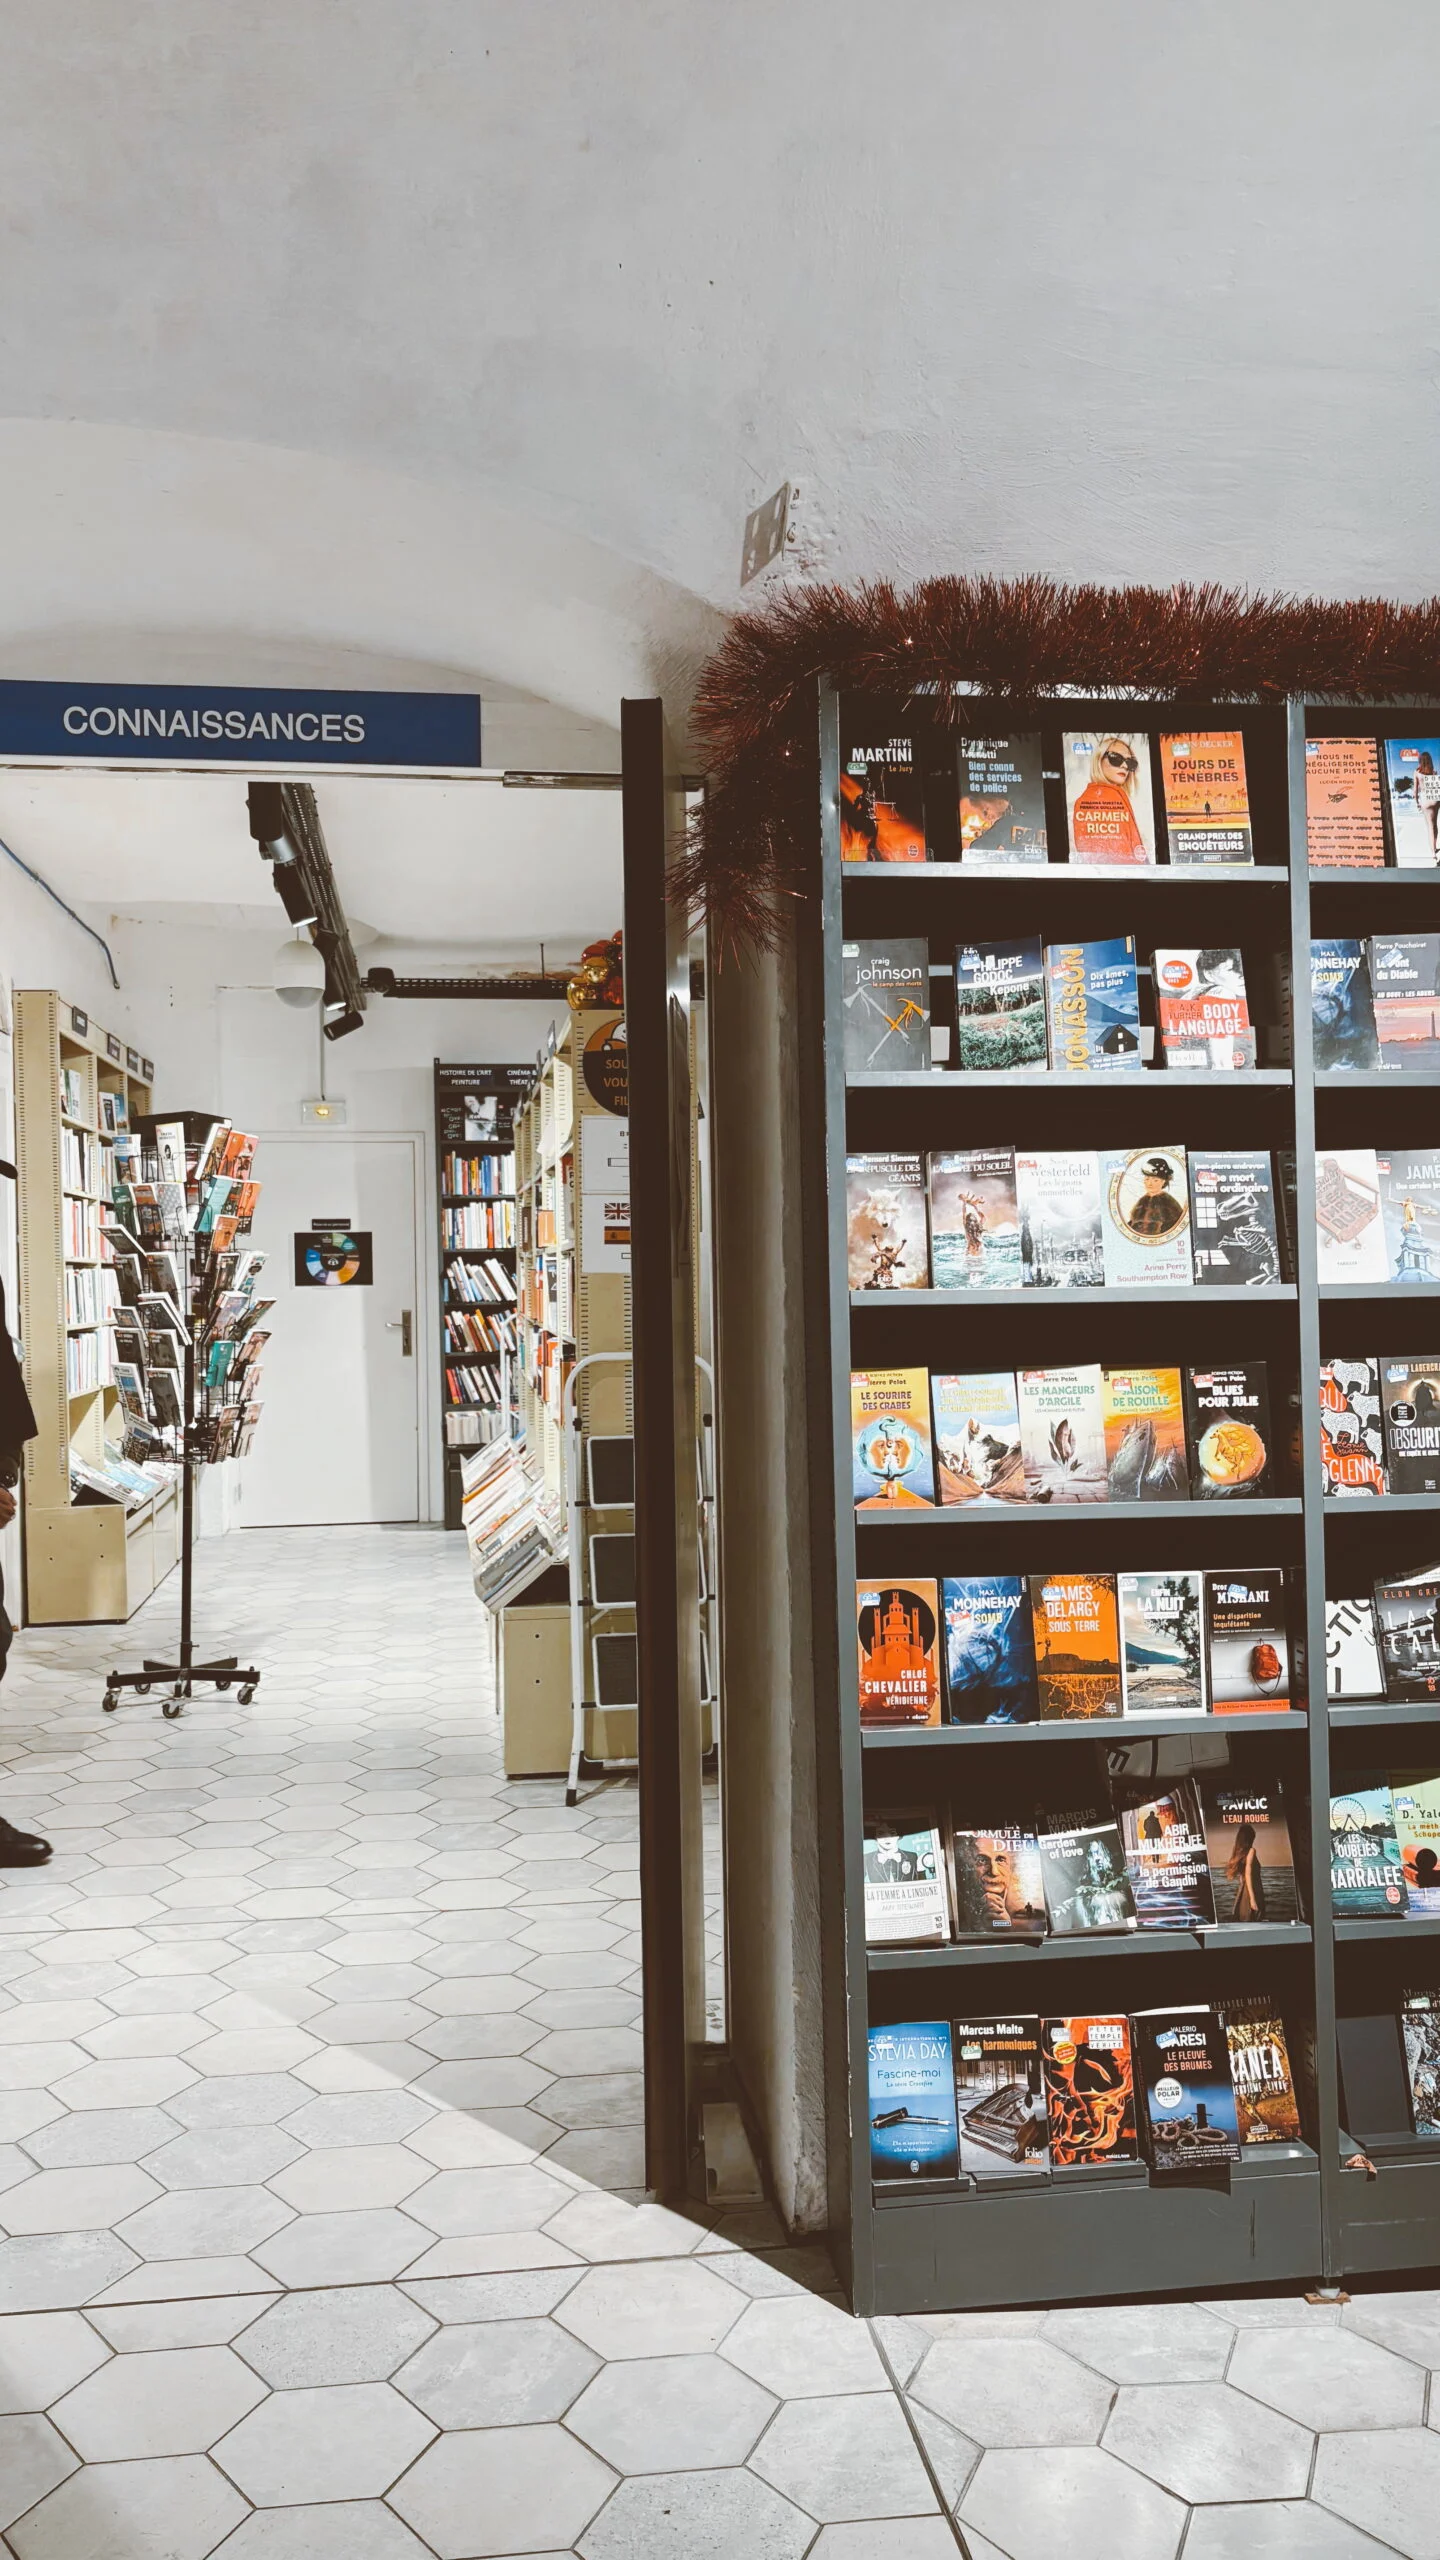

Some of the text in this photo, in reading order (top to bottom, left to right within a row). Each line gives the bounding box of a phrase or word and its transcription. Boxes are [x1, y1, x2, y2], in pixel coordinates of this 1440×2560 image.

[62, 705, 366, 743] CONNAISSANCES
[889, 739, 912, 747] STEVE
[852, 748, 912, 762] MARTINI
[969, 761, 986, 770] Bien
[1173, 759, 1235, 769] JOURS DE
[969, 772, 1022, 782] des services
[970, 782, 1007, 793] de police
[1076, 811, 1129, 822] CARMEN
[1087, 823, 1120, 833] RICCI
[1178, 832, 1206, 840] GRAND
[1207, 832, 1226, 840] PRIX
[1178, 840, 1244, 851] ENQUÊTEURS
[871, 957, 890, 966] craig
[856, 964, 921, 984] johnson
[973, 969, 1013, 984] GODOC
[1090, 972, 1104, 980] Dix
[1377, 970, 1418, 980] du Diable
[990, 983, 1029, 996] Kepone
[1090, 978, 1123, 990] pas plus
[1203, 1003, 1239, 1019] BODY
[1169, 1019, 1243, 1035] LANGUAGE
[974, 1162, 1012, 1172] DU SOLEIL
[888, 1173, 921, 1182] GÉANTS
[1229, 1173, 1255, 1182] mort
[1195, 1182, 1268, 1192] bien ordinaire
[1144, 1264, 1187, 1273] Anne Perry
[1117, 1274, 1168, 1283] Southampton
[861, 1391, 912, 1400] LE SOURIRE
[1024, 1386, 1095, 1395] LES MANGEURS
[1213, 1385, 1243, 1396] BLUES
[863, 1402, 877, 1410] DES
[1039, 1397, 1081, 1406] D'ARGILE
[1113, 1396, 1169, 1406] DE ROUILLE
[1198, 1396, 1259, 1408] POUR JULIE
[1212, 1583, 1227, 1591] Dror
[953, 1596, 1022, 1611] MONNEHAY
[1047, 1601, 1100, 1617] DELARGY
[1137, 1597, 1185, 1611] LA NUIT
[974, 1612, 1003, 1624] SOMB
[1227, 1612, 1261, 1620] disparition
[1049, 1620, 1100, 1632] SOUS TERRE
[900, 1667, 927, 1679] CHLOÉ
[865, 1680, 927, 1694] CHEVALIER
[886, 1695, 928, 1705] VÉRIDIENNE
[1046, 1809, 1097, 1825] MARCUS
[1223, 1814, 1270, 1823] L'EAU ROUGE
[1402, 1810, 1413, 1819] D.
[1163, 1823, 1189, 1837] ABIR
[1039, 1839, 1076, 1849] Garden
[1138, 1835, 1202, 1850] MUKHERJEE
[1348, 1834, 1362, 1843] LES
[992, 1840, 1034, 1852] DIEU
[1338, 1842, 1381, 1858] OUBLIÉS
[1050, 1847, 1084, 1859] of love
[1166, 1853, 1192, 1863] Avec
[1139, 1863, 1207, 1877] la permission
[1146, 1875, 1198, 1888] de Gandhi
[866, 1891, 875, 1900] LA
[876, 1888, 900, 1900] FEMME
[959, 2024, 1024, 2036] Marcus Malte
[983, 2040, 1037, 2051] harmoniques
[868, 2042, 947, 2062] SYLVIA DAY
[1167, 2050, 1206, 2060] LE FLEUVE
[1164, 2060, 1212, 2072] DES BRUMES
[878, 2068, 941, 2079] Fascine-moi
[1158, 2090, 1180, 2098] POLAR
[1024, 2147, 1043, 2158] folio
